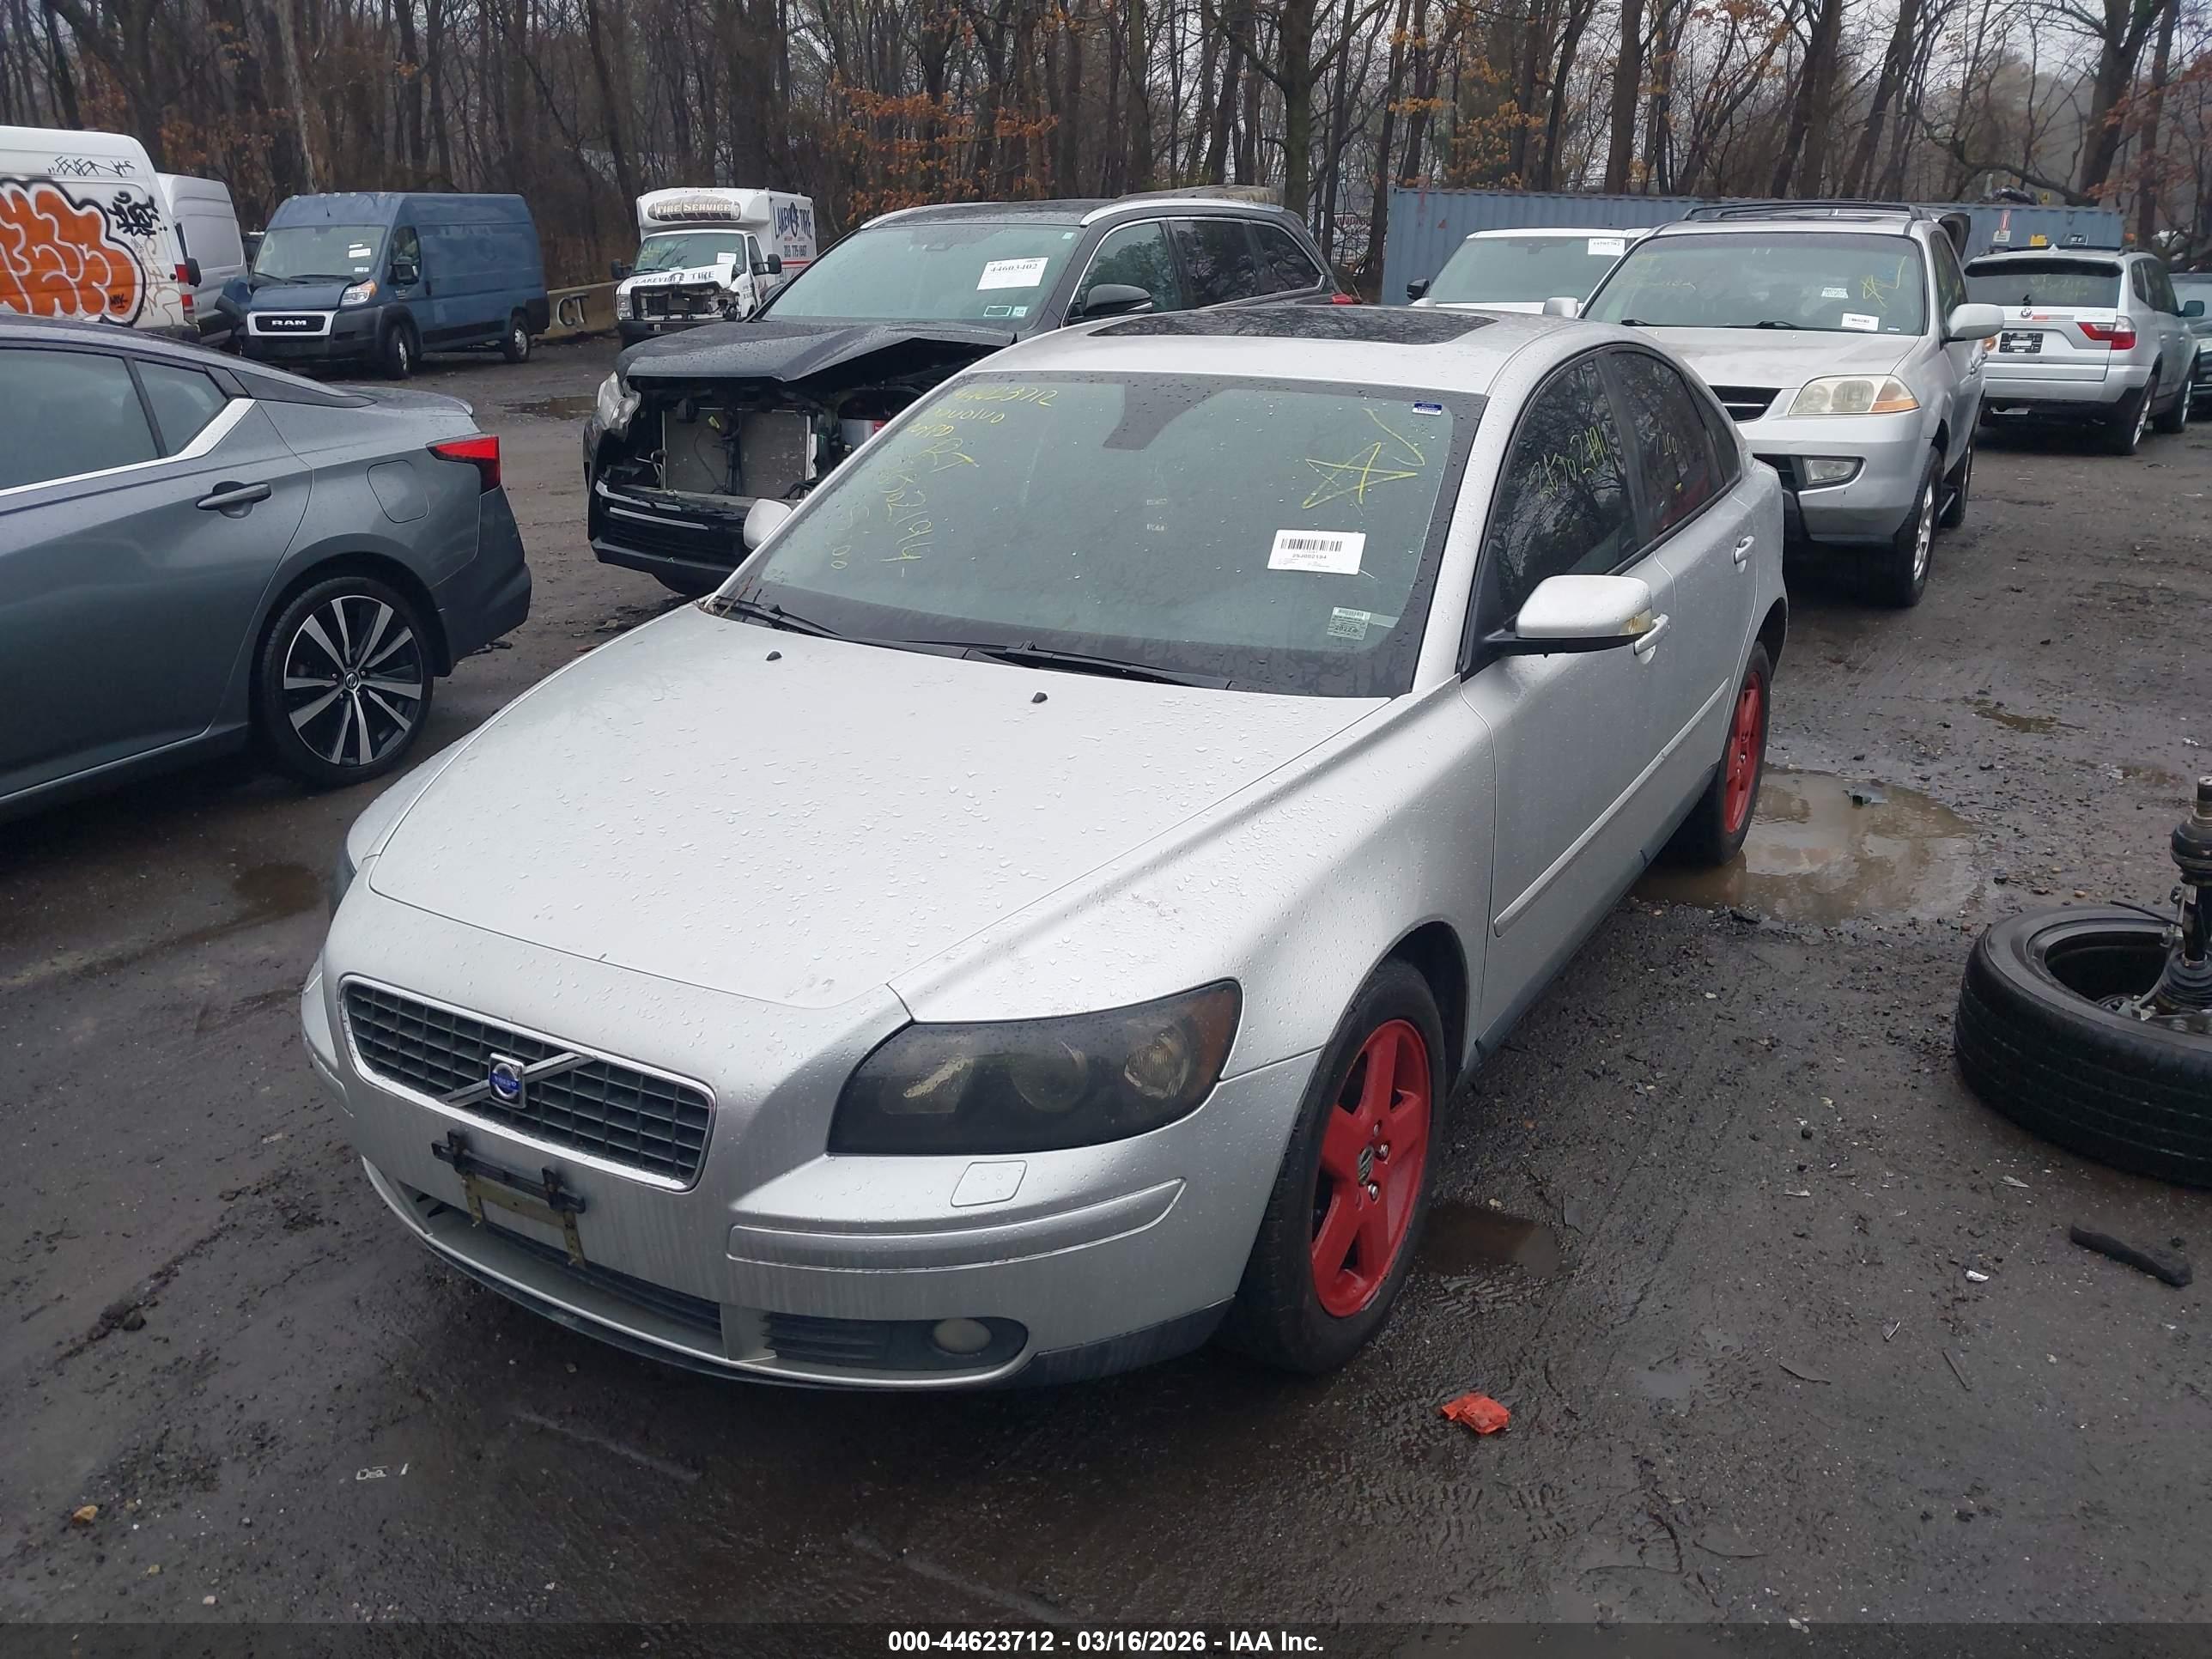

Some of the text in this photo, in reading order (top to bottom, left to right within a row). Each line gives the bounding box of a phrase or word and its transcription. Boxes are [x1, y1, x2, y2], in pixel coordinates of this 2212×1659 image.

[657, 202, 731, 214] TIRE SERVICE
[690, 270, 715, 282] TIRE
[494, 1075, 517, 1087] VOLVO
